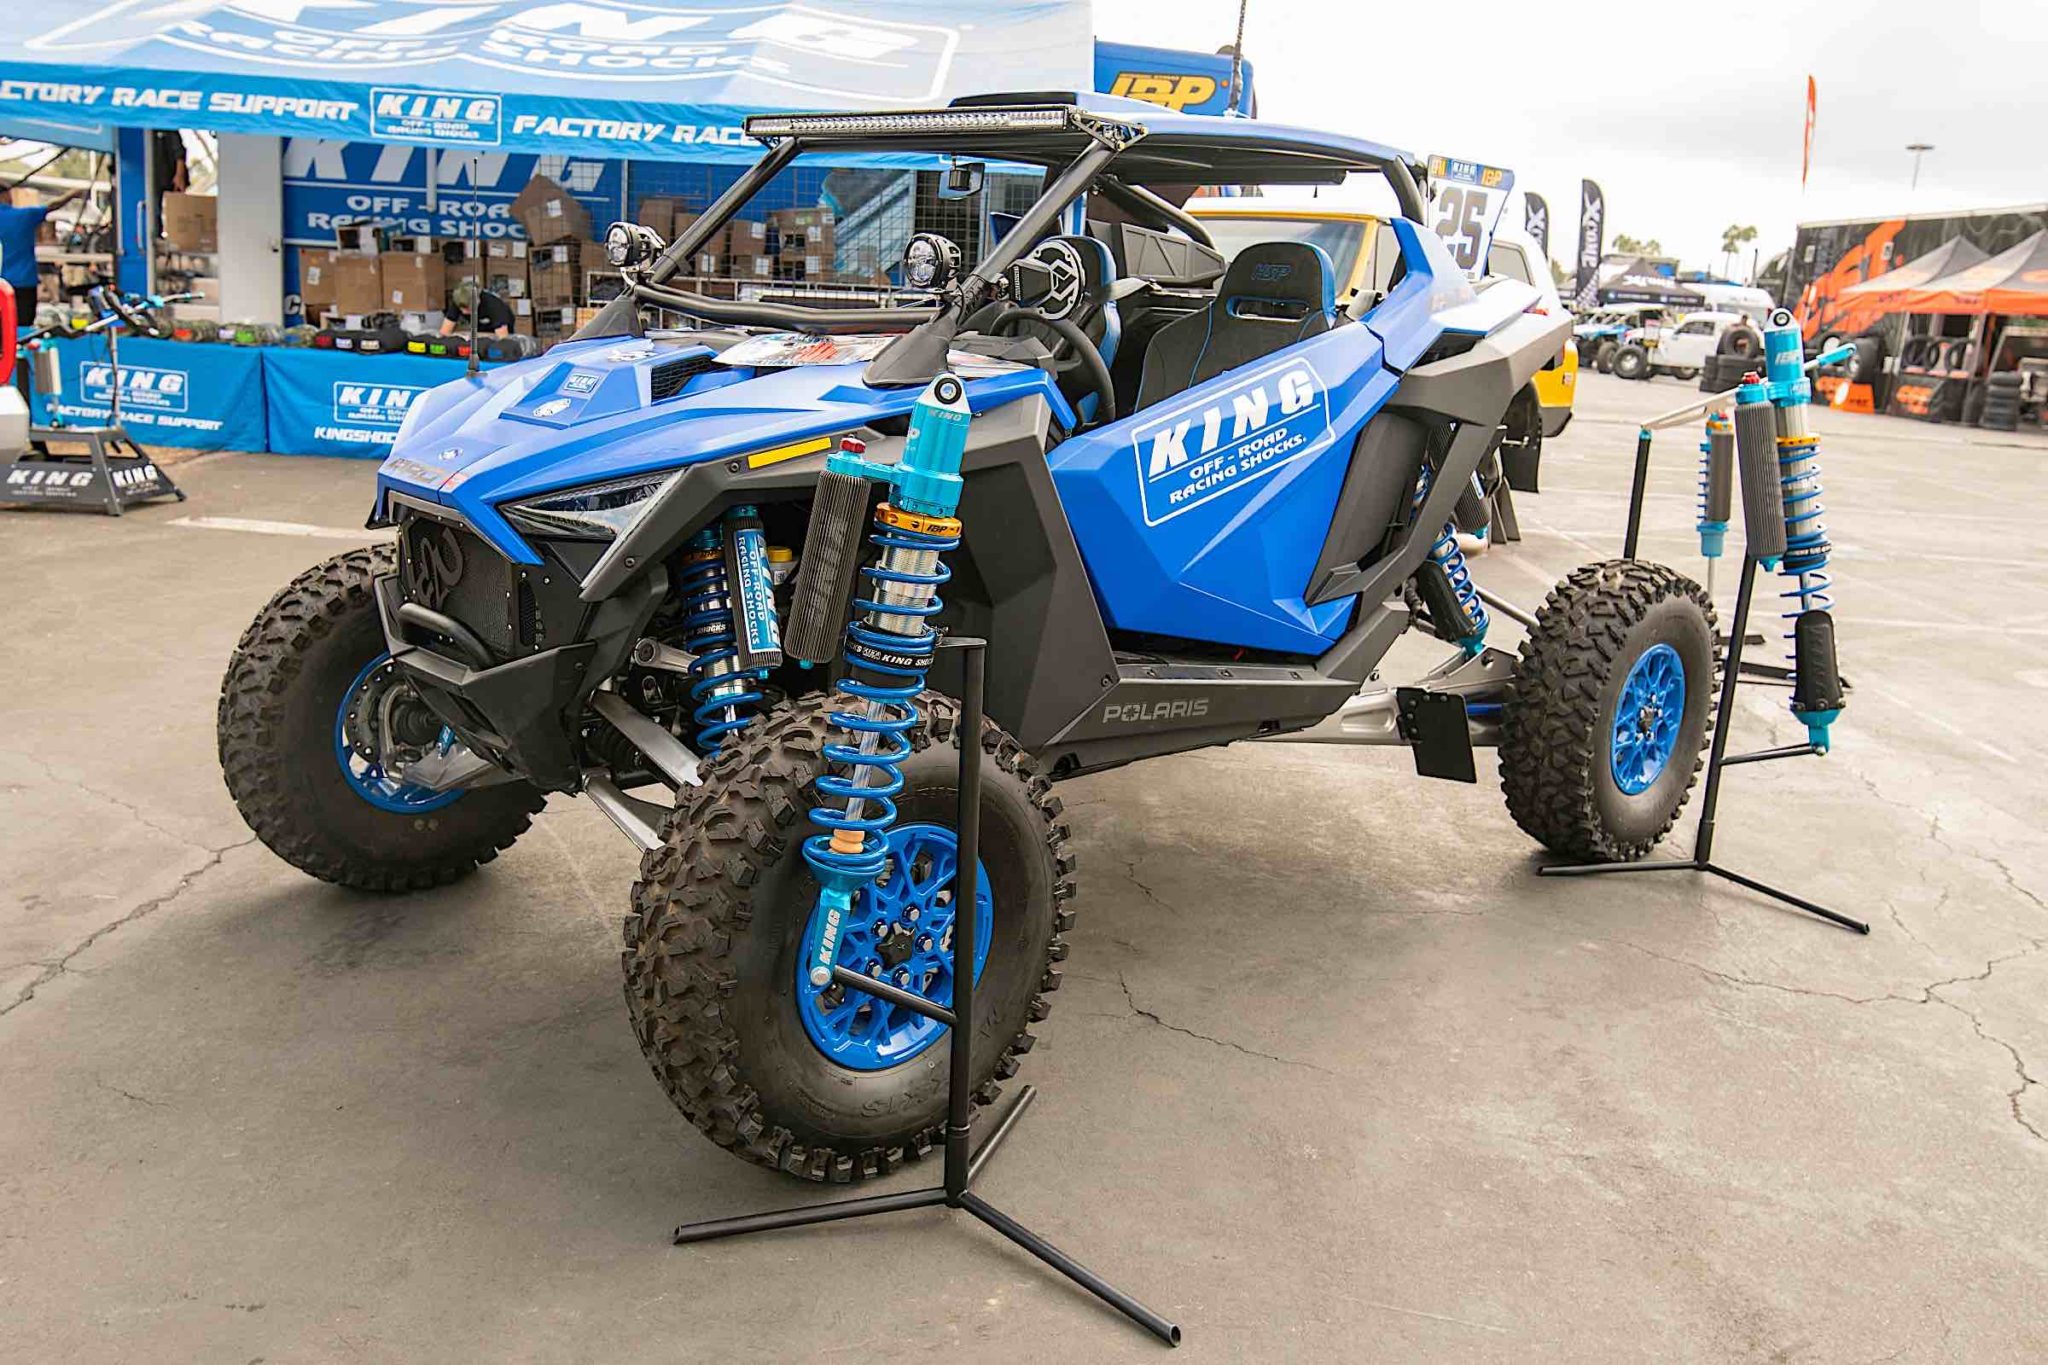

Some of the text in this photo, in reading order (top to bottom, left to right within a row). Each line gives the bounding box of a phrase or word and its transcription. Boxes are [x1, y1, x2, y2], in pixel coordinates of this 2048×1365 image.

[111, 87, 202, 110] RACE
[208, 92, 359, 121] SUPPORT
[377, 93, 496, 121] KING
[512, 115, 666, 143] FACTORY
[346, 195, 410, 214] OFF
[1435, 186, 1489, 271] 25
[86, 366, 184, 393] KING
[157, 415, 223, 431] SUPPORT
[1149, 370, 1315, 478] KING
[1189, 453, 1225, 479] OFF
[1238, 427, 1288, 459] ROAD
[7, 469, 93, 487] KING
[112, 464, 159, 487] KING
[1169, 465, 1237, 504] RACING
[738, 536, 760, 645] RACING SHOCKS
[882, 654, 912, 666] KING
[1103, 699, 1209, 723] POLARIS
[818, 908, 841, 966] KING
